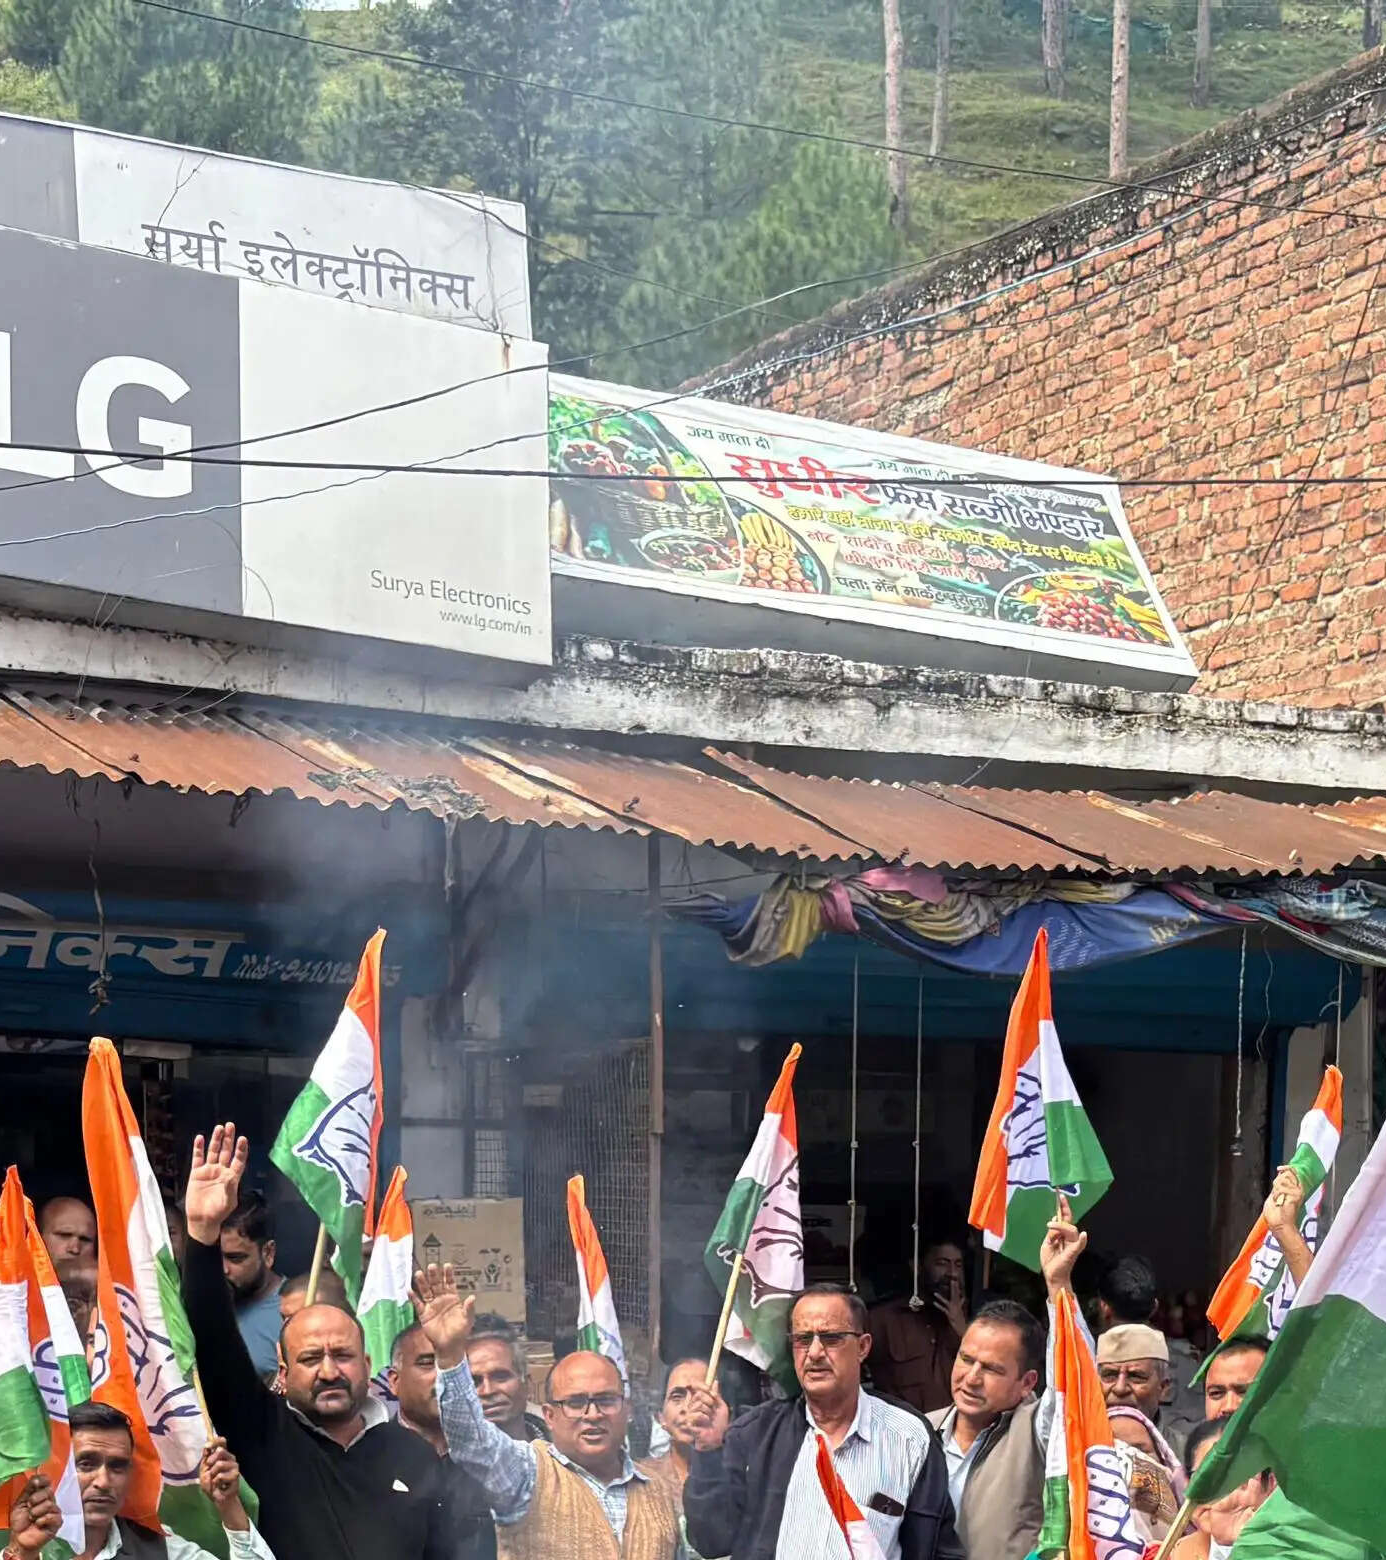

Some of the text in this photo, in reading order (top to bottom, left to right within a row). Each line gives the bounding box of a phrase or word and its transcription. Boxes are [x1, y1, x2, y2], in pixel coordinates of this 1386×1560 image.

[686, 426, 714, 440] जय
[718, 431, 750, 446] माता
[725, 452, 880, 504] सुधीर
[370, 569, 532, 615] Surya Electronics
[439, 609, 532, 636] www.lg.com/in
